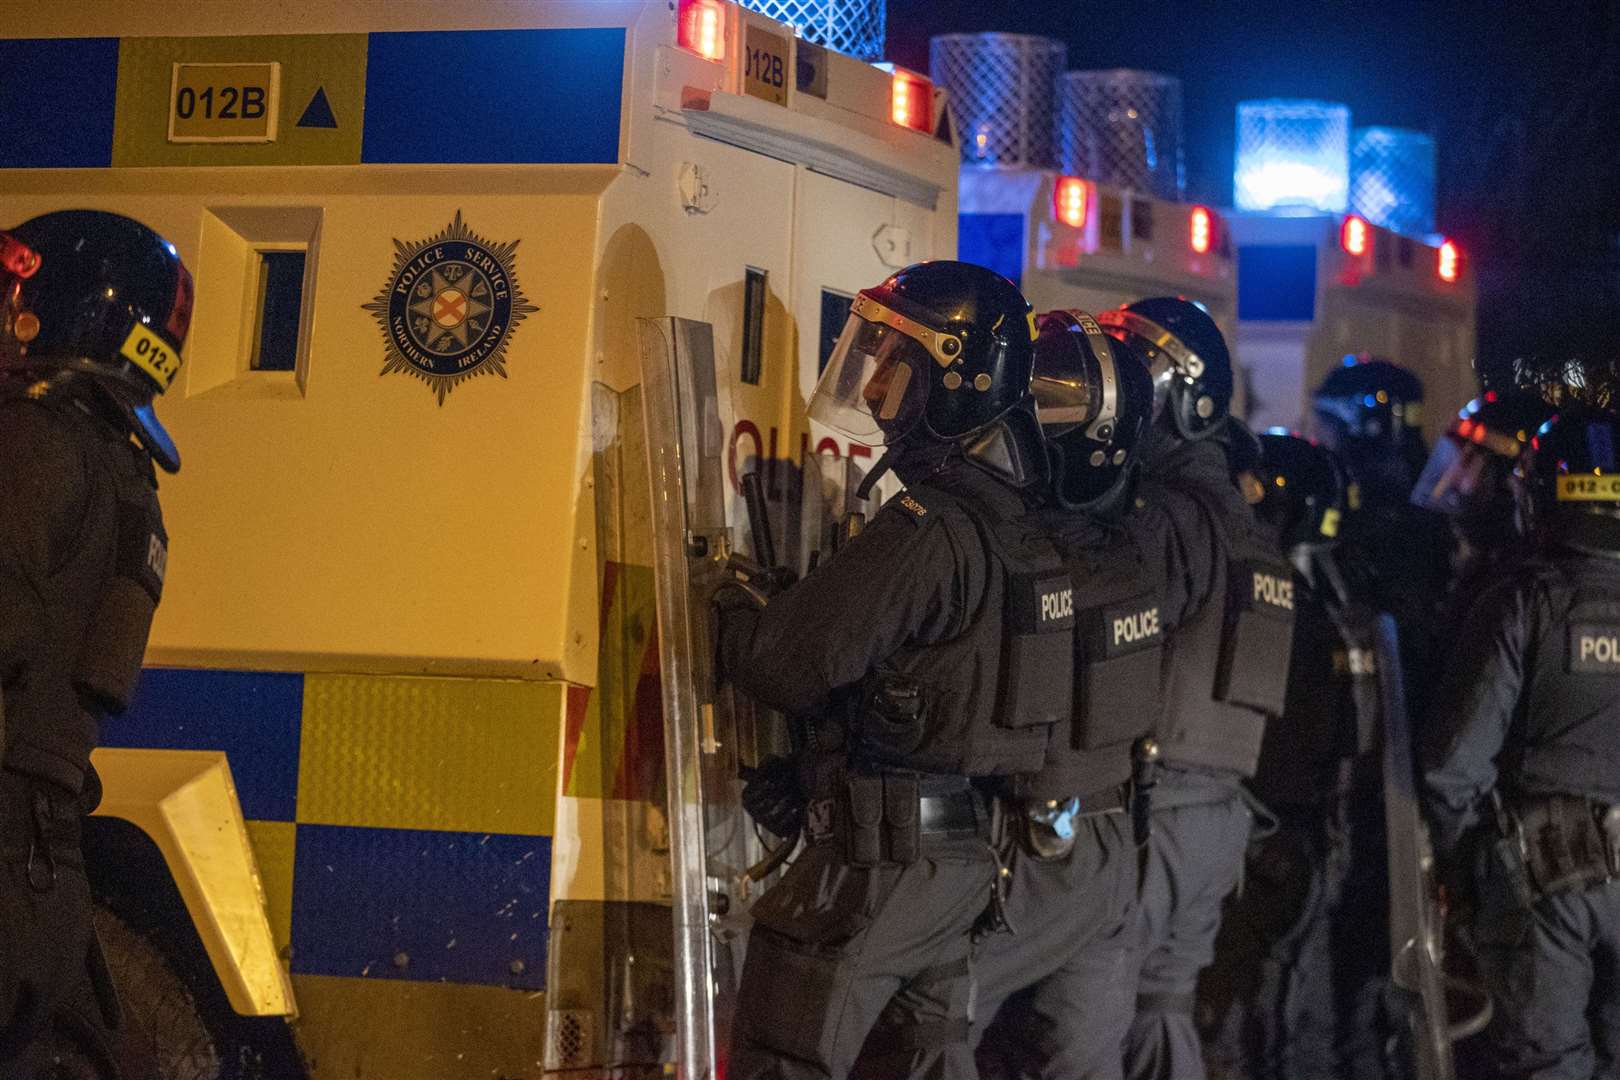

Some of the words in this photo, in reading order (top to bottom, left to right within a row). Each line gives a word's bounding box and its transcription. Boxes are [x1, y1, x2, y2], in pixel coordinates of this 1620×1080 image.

[176, 86, 266, 119] 012B
[396, 247, 445, 294] POLICE
[464, 247, 509, 300] SERVICE
[392, 312, 435, 369] NORTHERN
[456, 324, 501, 368] IRELAND
[1041, 589, 1073, 621] POLICE
[1252, 572, 1295, 610] POLICE
[1113, 608, 1160, 645] POLICE
